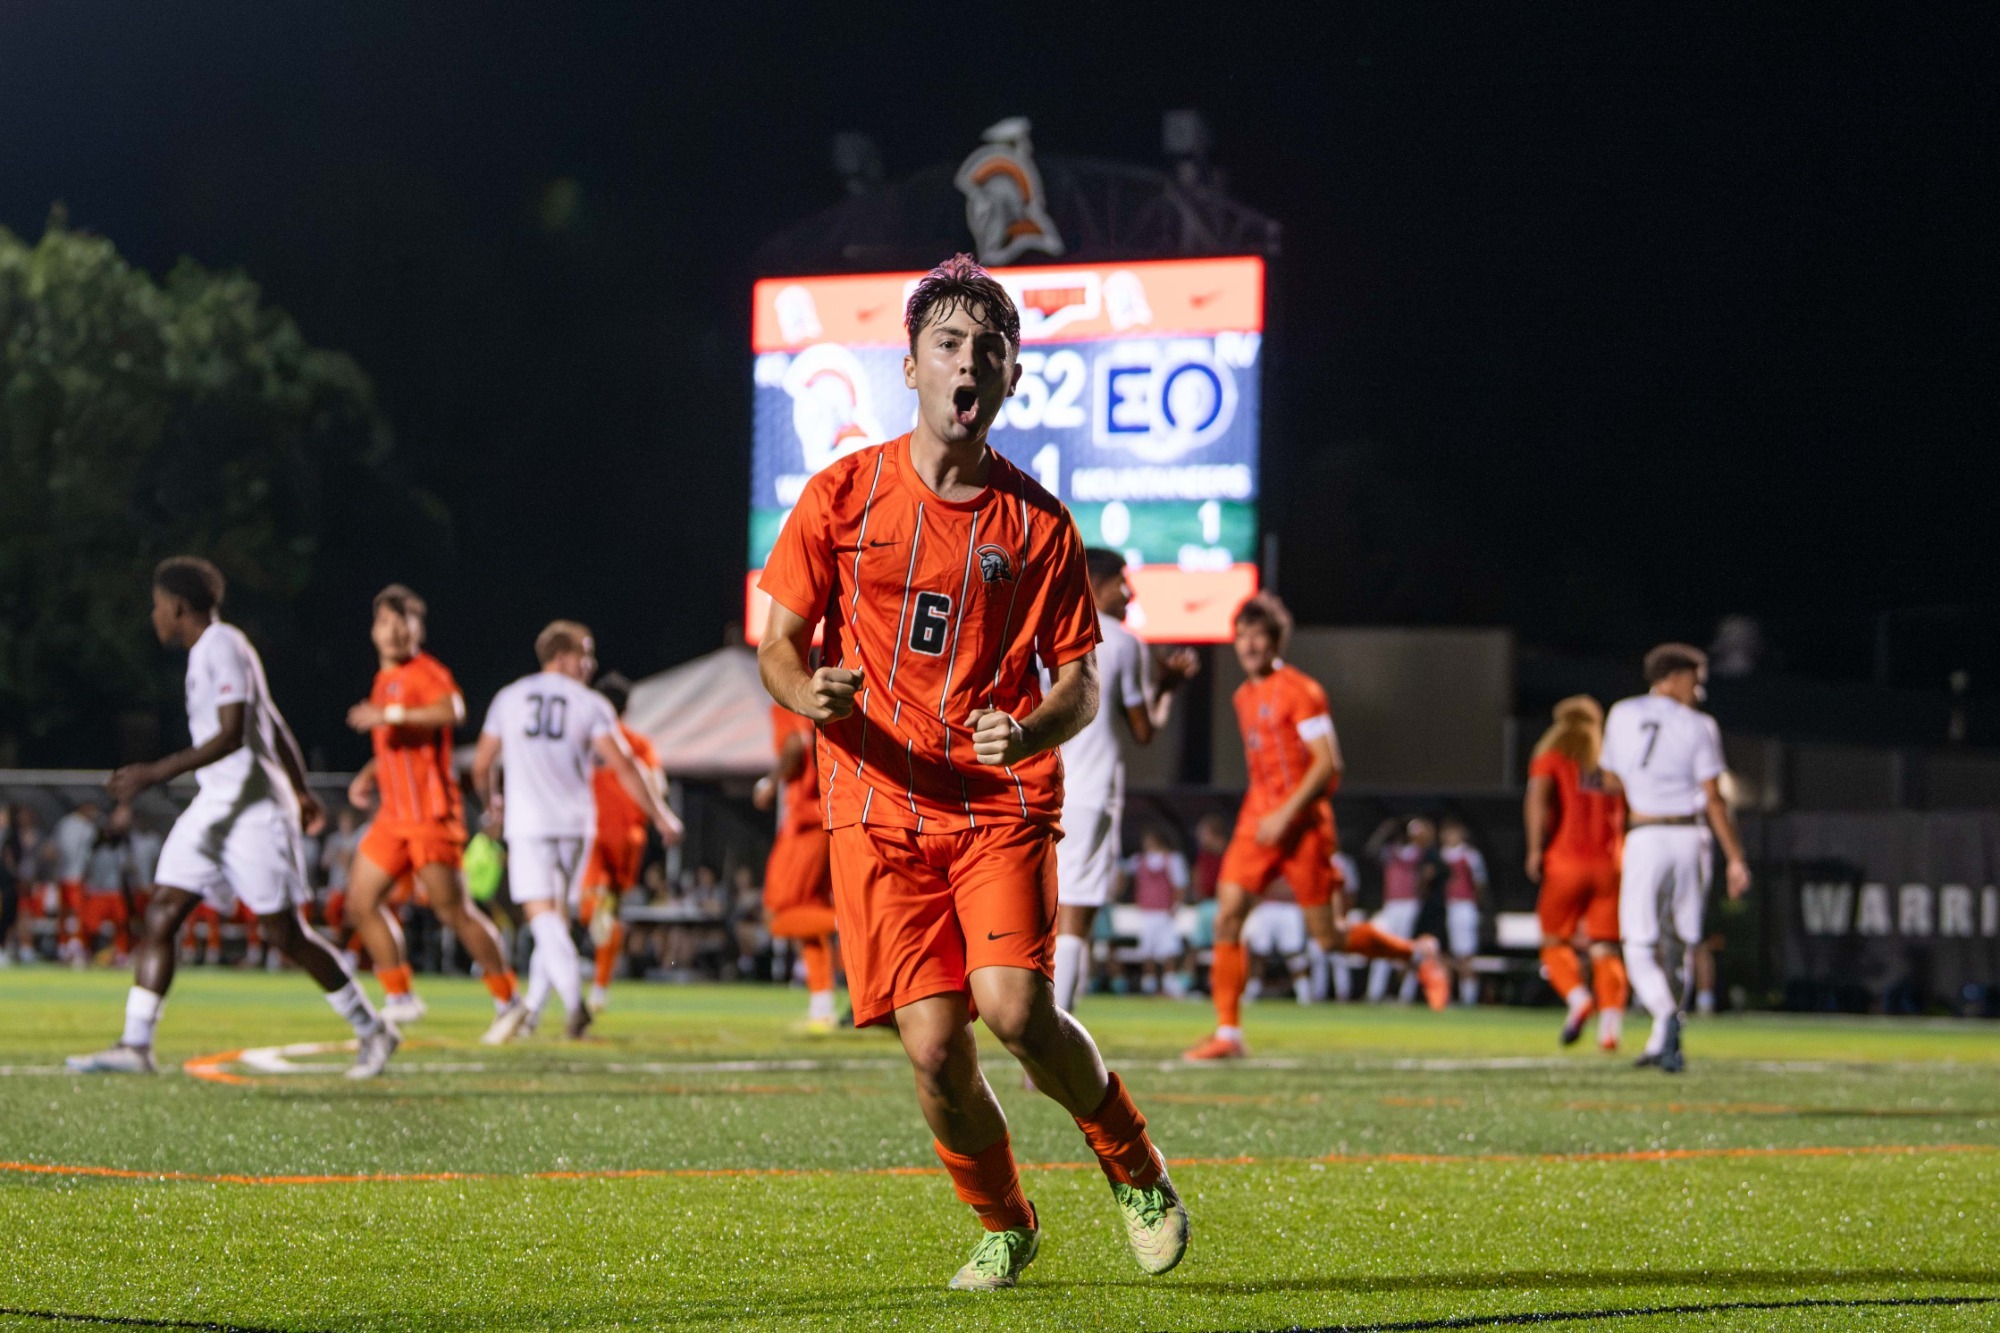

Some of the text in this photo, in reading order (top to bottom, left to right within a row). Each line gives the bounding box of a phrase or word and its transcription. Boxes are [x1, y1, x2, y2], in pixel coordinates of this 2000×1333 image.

[1031, 443, 1060, 499] 1
[1101, 500, 1131, 547] 0
[1198, 499, 1221, 545] 1
[908, 590, 952, 656] 6
[524, 693, 567, 741] 30
[1640, 721, 1660, 769] 7
[1800, 881, 1999, 938] WARRI
